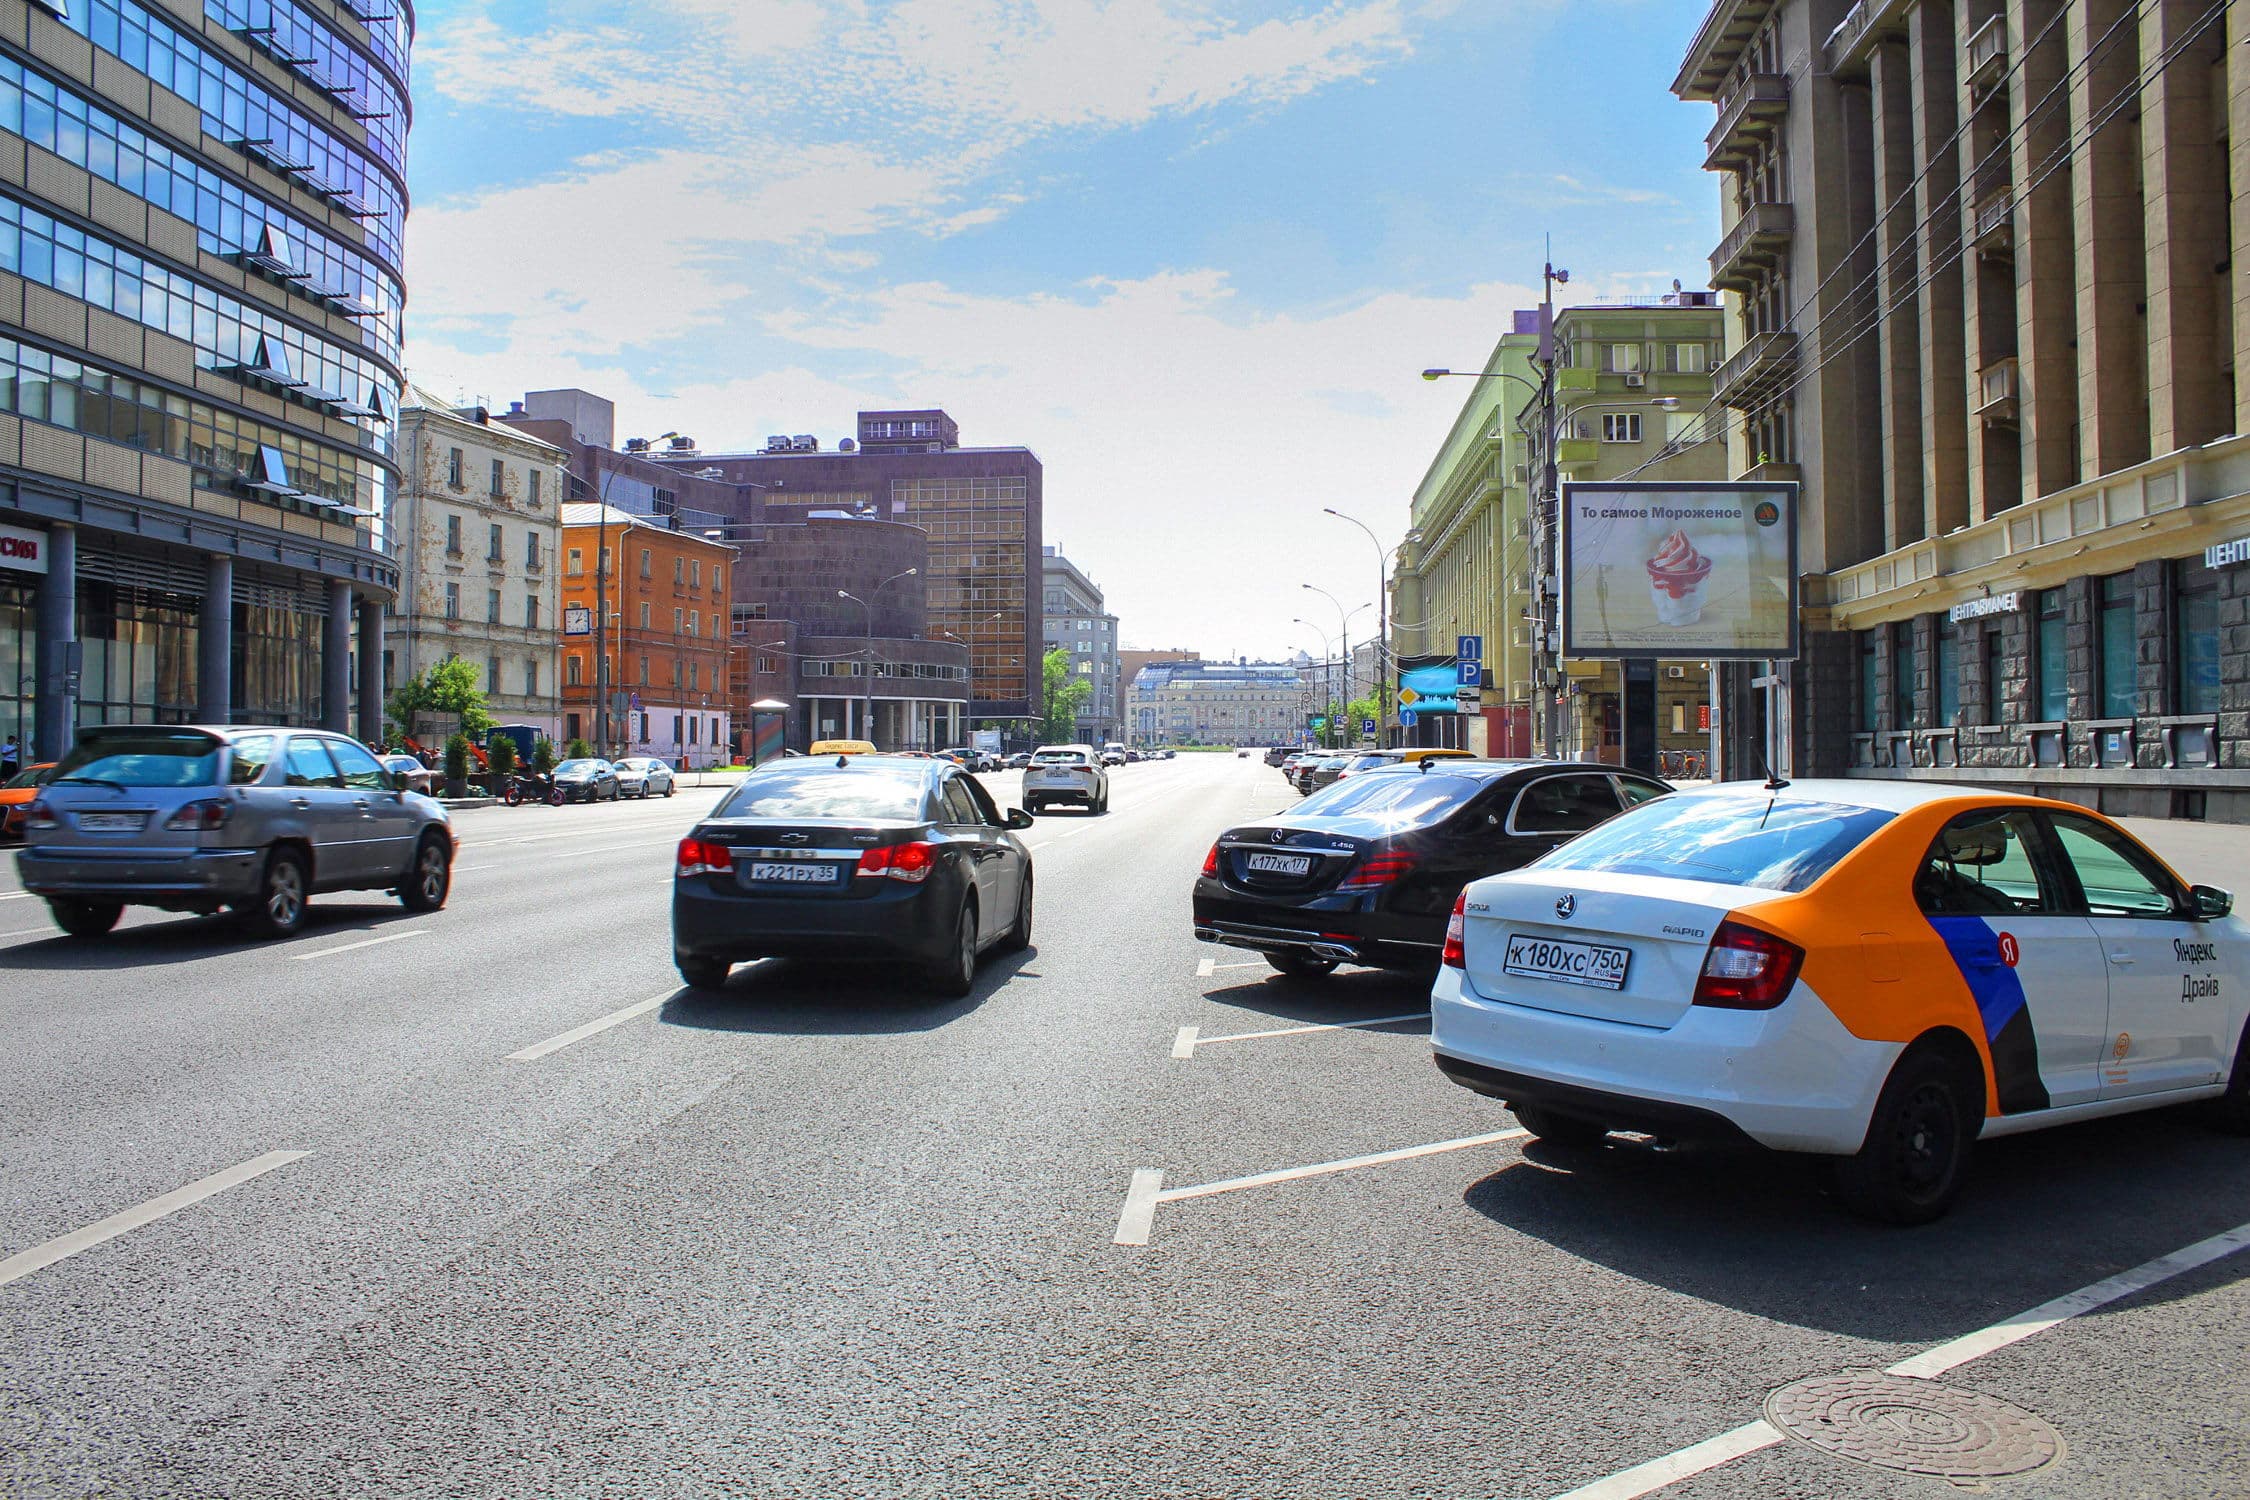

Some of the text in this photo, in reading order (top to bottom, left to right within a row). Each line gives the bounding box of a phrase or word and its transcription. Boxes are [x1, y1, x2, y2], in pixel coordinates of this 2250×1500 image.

[1581, 507, 1742, 521] То самое Мороженое
[0, 536, 38, 560] СИЯ
[2205, 537, 2250, 569] ЦЕНТ
[1949, 591, 2019, 623] ЦЕНТРАВИАМЕД
[819, 866, 833, 878] 35
[1662, 924, 1705, 938] RAPID
[1591, 949, 1620, 969] 750
[2002, 938, 2014, 962] Я
[2173, 938, 2217, 965] Яндекс
[1594, 968, 1610, 977] RUS
[2181, 973, 2219, 1002] Драйв
